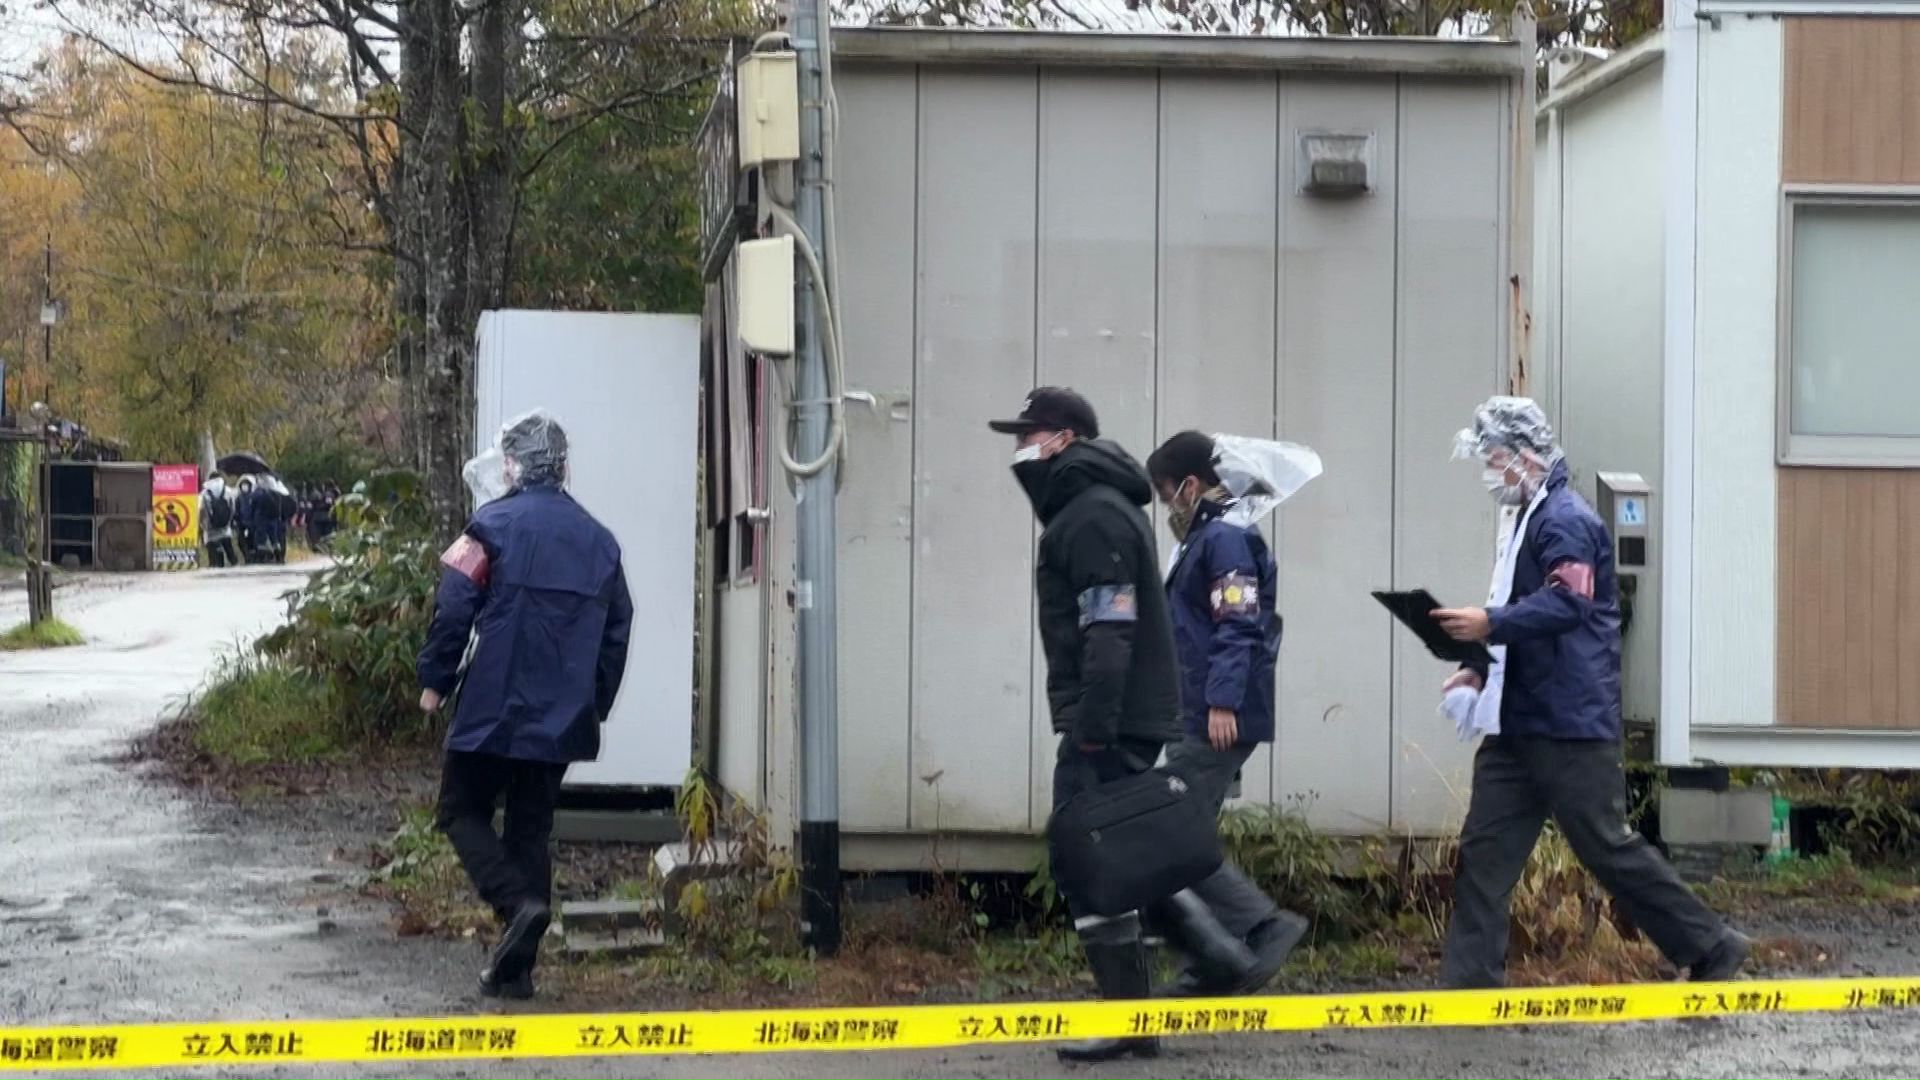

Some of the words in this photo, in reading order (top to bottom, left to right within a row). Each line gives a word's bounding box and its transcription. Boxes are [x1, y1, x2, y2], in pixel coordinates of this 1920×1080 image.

[1, 1036, 118, 1060] 海道警察
[180, 1031, 303, 1056] 立入禁止
[365, 1028, 517, 1053] 北海道警察
[577, 1023, 693, 1047] 立入禁止
[754, 1019, 899, 1044] 北海道警察
[957, 1013, 1070, 1037] 立入禁止
[1128, 1008, 1268, 1034] 北海道警察
[1323, 1002, 1432, 1026] 立入禁止
[1489, 997, 1628, 1019] 北海道警察
[1681, 991, 1788, 1013] 立入禁止
